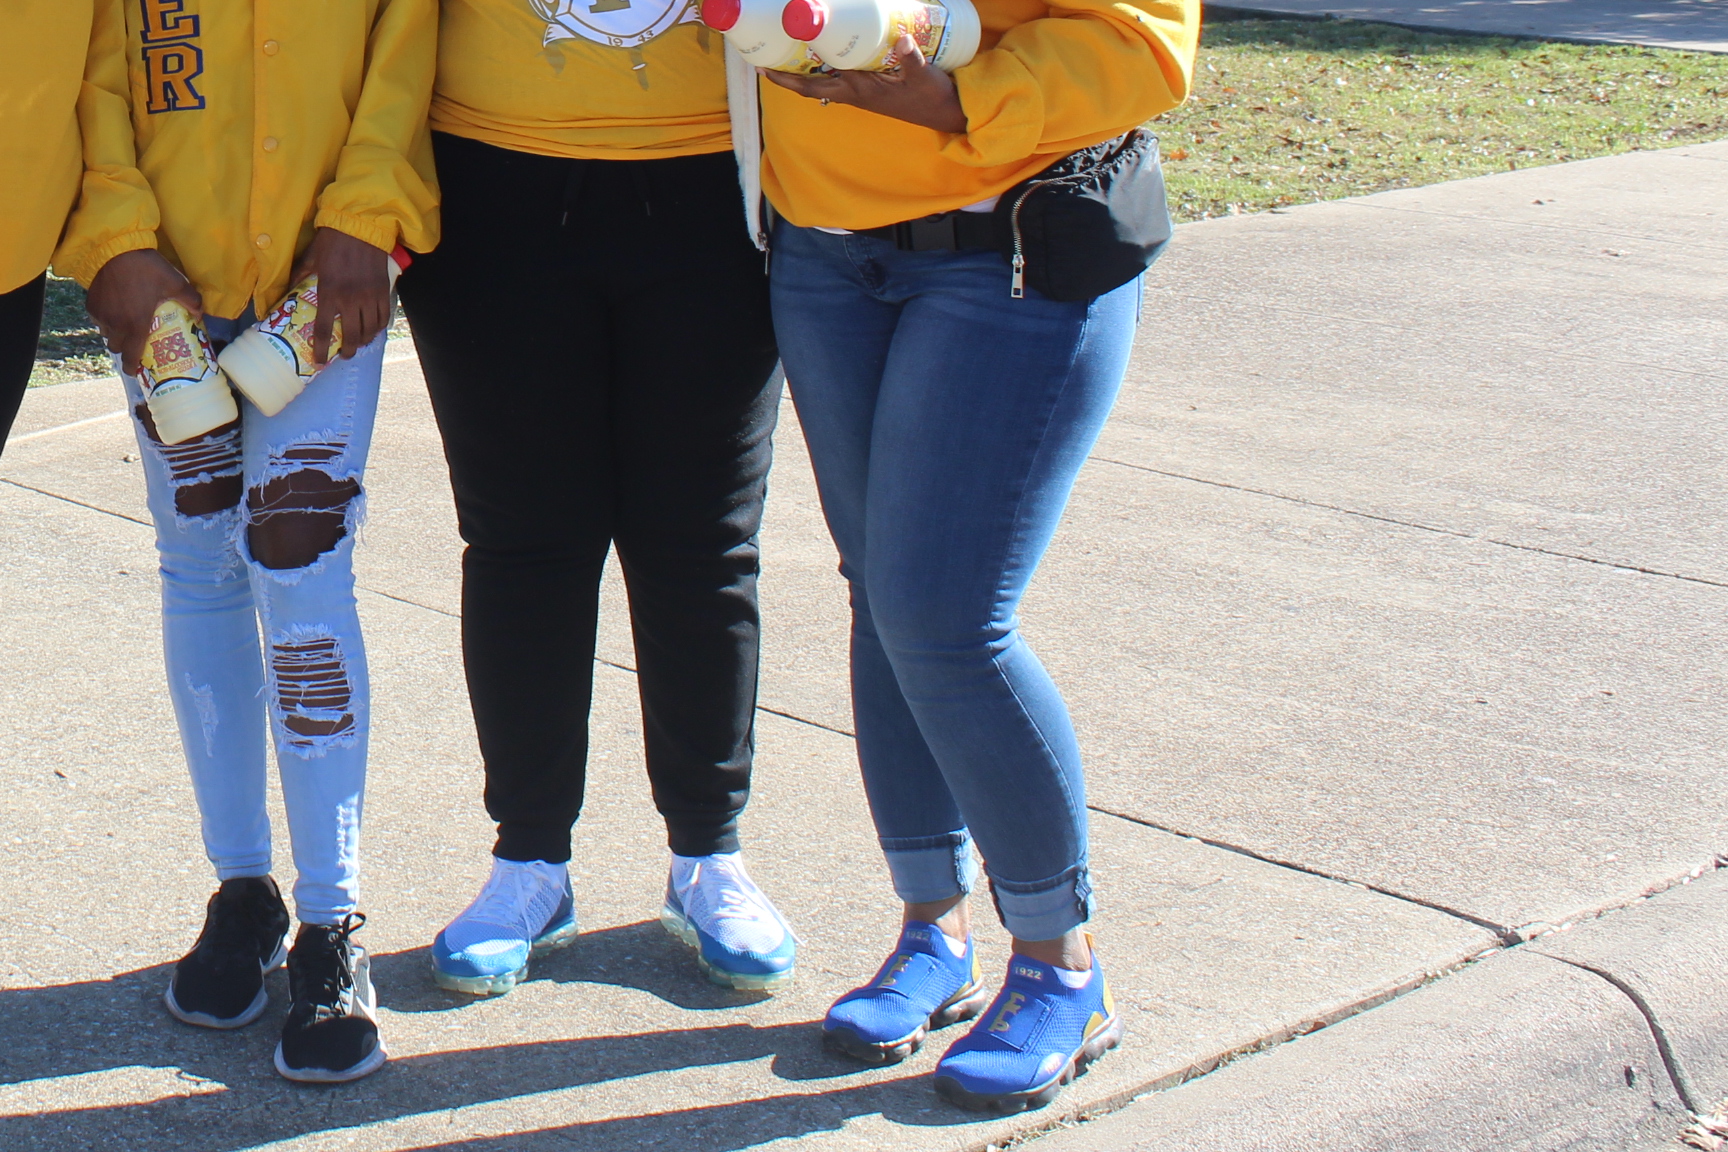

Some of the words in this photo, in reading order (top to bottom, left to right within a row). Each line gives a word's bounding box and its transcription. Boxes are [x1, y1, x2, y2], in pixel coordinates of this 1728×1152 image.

[607, 36, 624, 47] 19
[637, 29, 655, 44] 43
[150, 332, 185, 355] EGG
[153, 343, 192, 367] NOG
[906, 930, 930, 940] 1922
[1014, 966, 1042, 980] 1922
